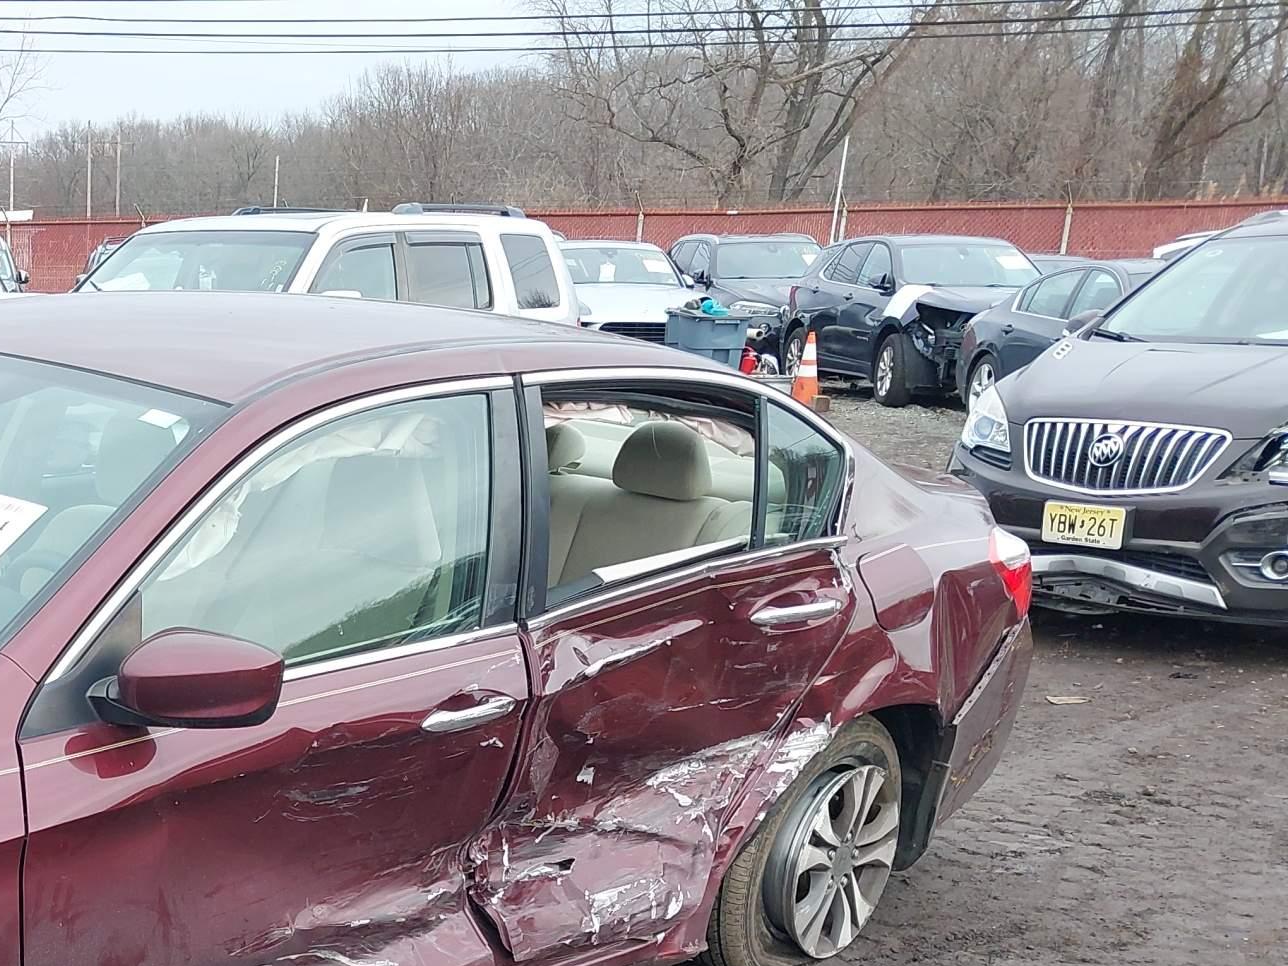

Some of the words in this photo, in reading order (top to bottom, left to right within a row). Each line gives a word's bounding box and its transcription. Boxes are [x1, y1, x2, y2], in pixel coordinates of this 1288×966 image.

[1064, 505, 1081, 514] New
[1082, 507, 1105, 516] Jersey
[1060, 534, 1083, 543] Garden
[1084, 536, 1101, 544] State
